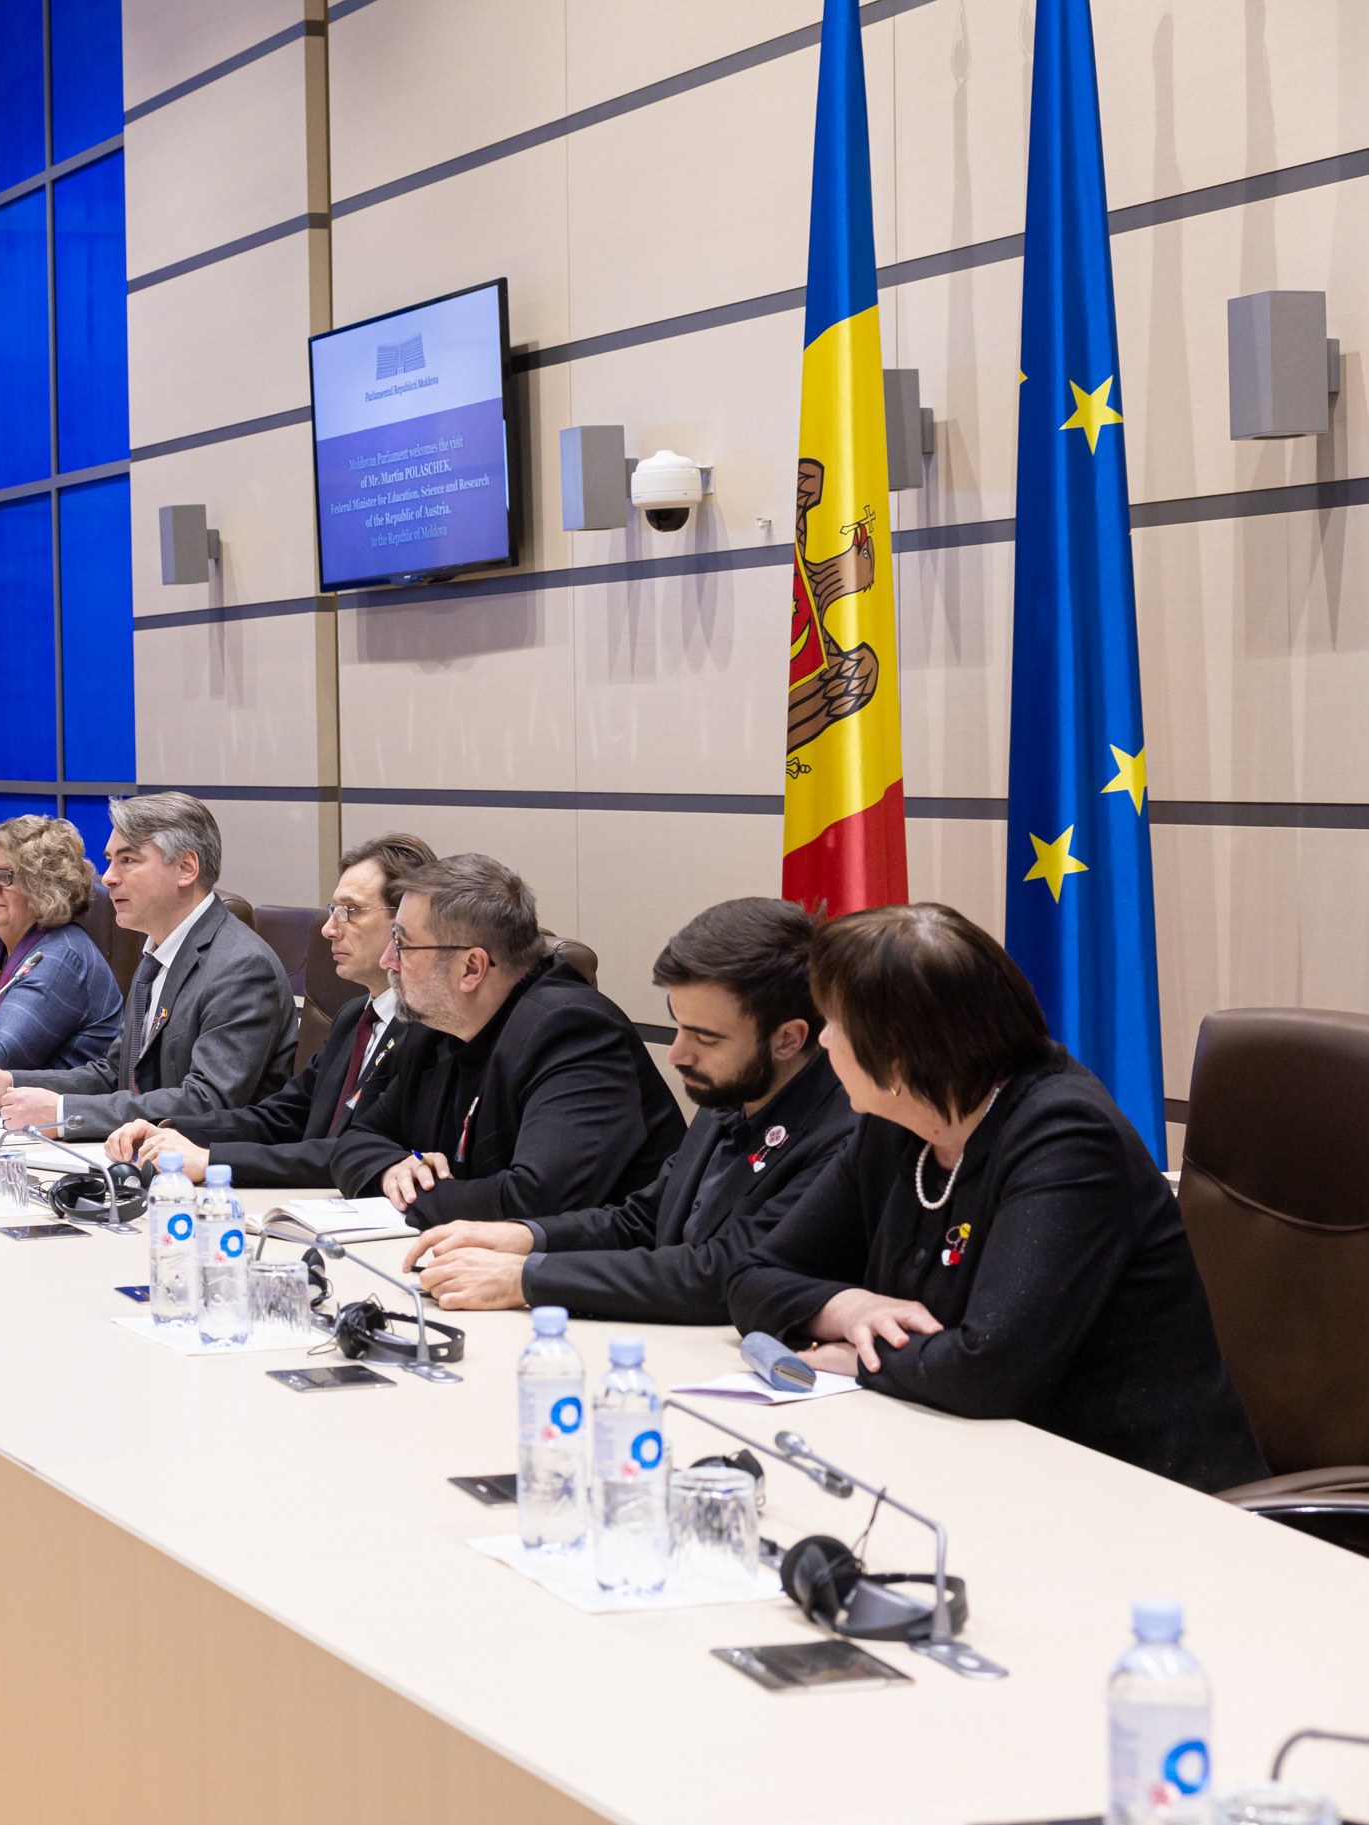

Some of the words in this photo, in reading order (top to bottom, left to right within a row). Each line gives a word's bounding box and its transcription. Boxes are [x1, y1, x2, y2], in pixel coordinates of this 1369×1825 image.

[360, 475, 368, 489] of
[368, 474, 380, 487] Mr.
[381, 468, 404, 485] Martin
[366, 514, 373, 528] of
[373, 514, 384, 527] the
[385, 507, 414, 527] Republic
[415, 505, 423, 518] of
